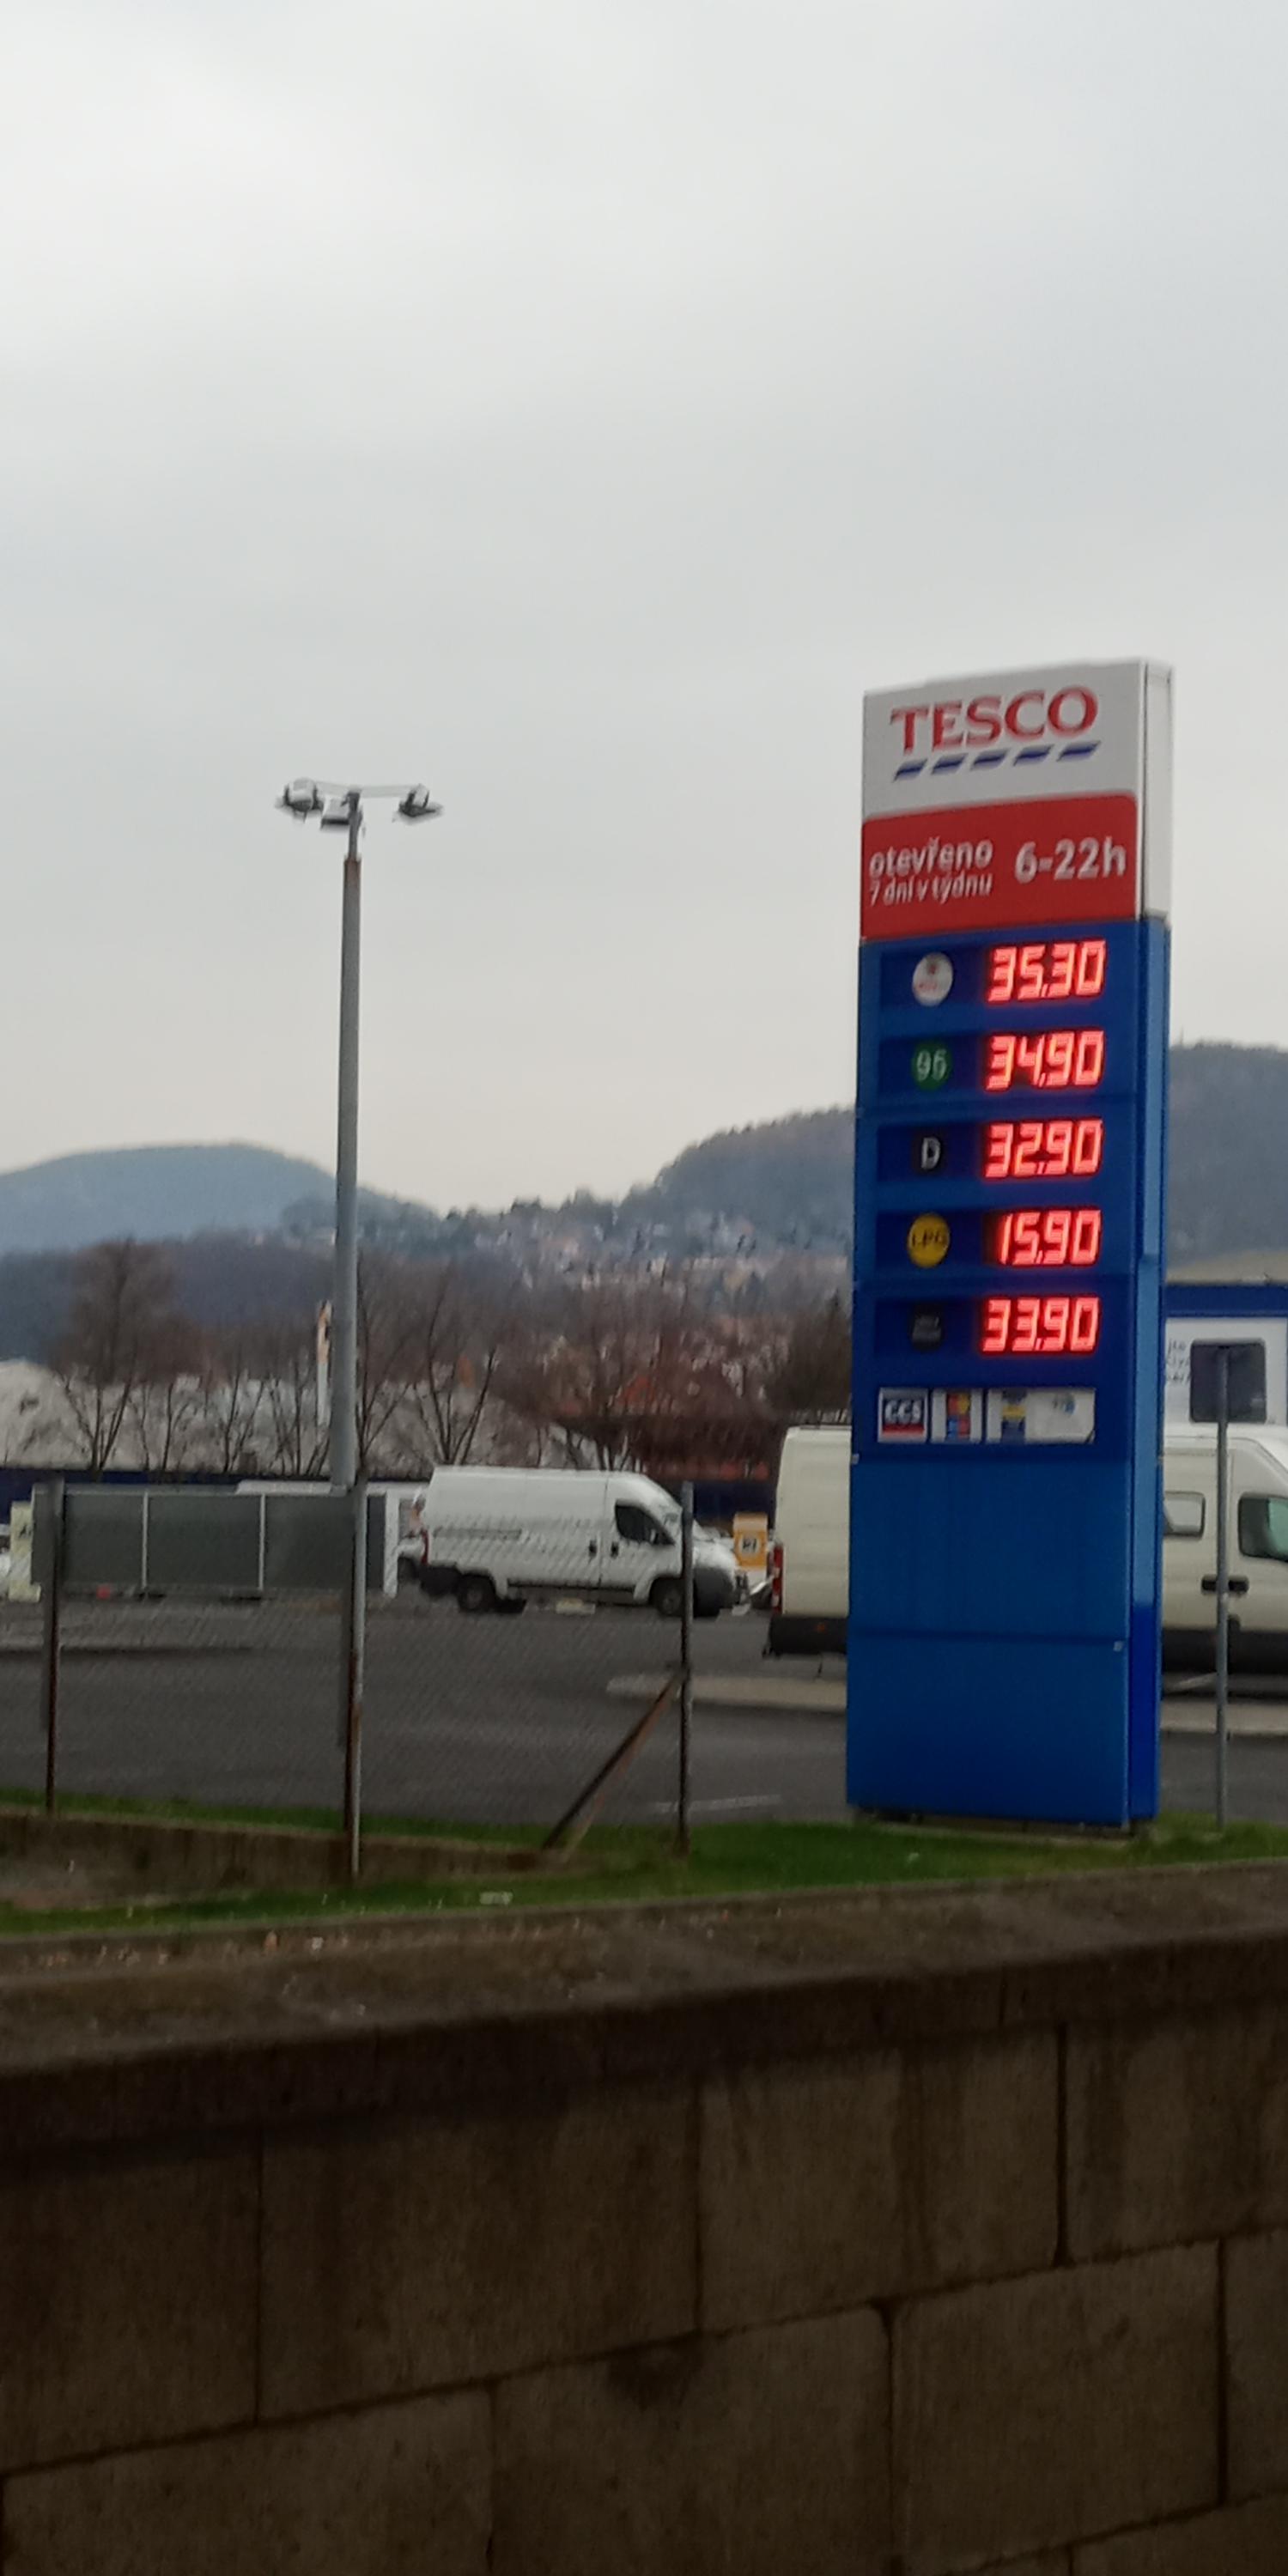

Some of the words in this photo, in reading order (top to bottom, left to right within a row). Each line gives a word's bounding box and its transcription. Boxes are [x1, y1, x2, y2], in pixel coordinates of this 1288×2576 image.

[890, 684, 1098, 754] TESCO
[869, 835, 993, 878] otevřeno
[1014, 836, 1127, 884] 6-22h
[918, 878, 930, 902] v
[932, 869, 993, 905] týdnu
[921, 1137, 941, 1170] D
